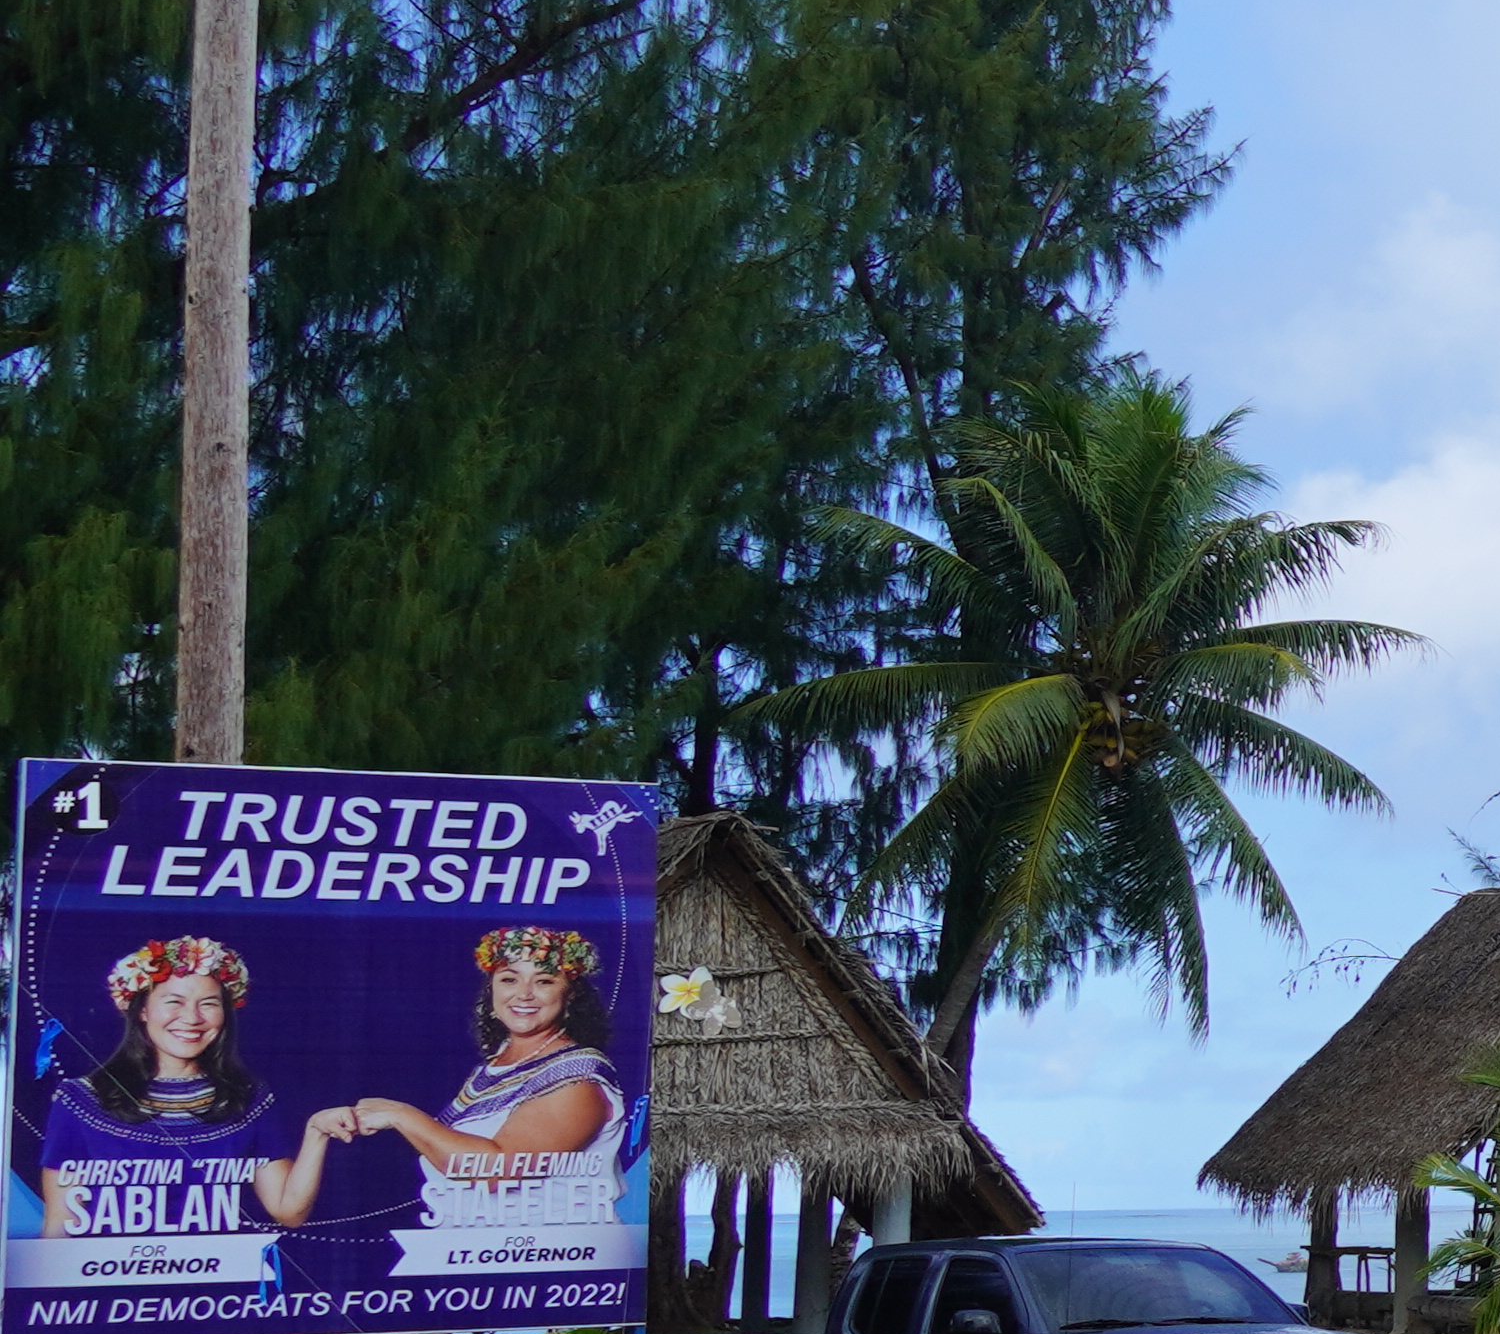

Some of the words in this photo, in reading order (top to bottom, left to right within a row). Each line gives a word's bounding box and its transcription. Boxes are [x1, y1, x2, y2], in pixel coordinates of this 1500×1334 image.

[53, 781, 109, 829] #1
[178, 790, 528, 850] TRUSTED
[100, 845, 591, 906] LEADERSHIP
[57, 1158, 184, 1186] CHRISTINA
[192, 1156, 270, 1185] "TINA"
[446, 1153, 504, 1178] LEILA
[509, 1150, 604, 1177] FLEMING
[63, 1184, 242, 1235] SABLAN
[419, 1177, 616, 1228] STAFFLER
[130, 1243, 166, 1259] FOR
[446, 1247, 475, 1264] LT.
[478, 1245, 596, 1264] GOVERNOR
[504, 1234, 536, 1249] FOR
[80, 1257, 221, 1277] GOVERNOR
[27, 1299, 98, 1326] NMI
[106, 1292, 331, 1324] DEMOCRATS
[340, 1288, 414, 1315] FOR
[424, 1286, 494, 1313] YOU
[502, 1284, 536, 1310] IN
[542, 1281, 626, 1308] 2022!
